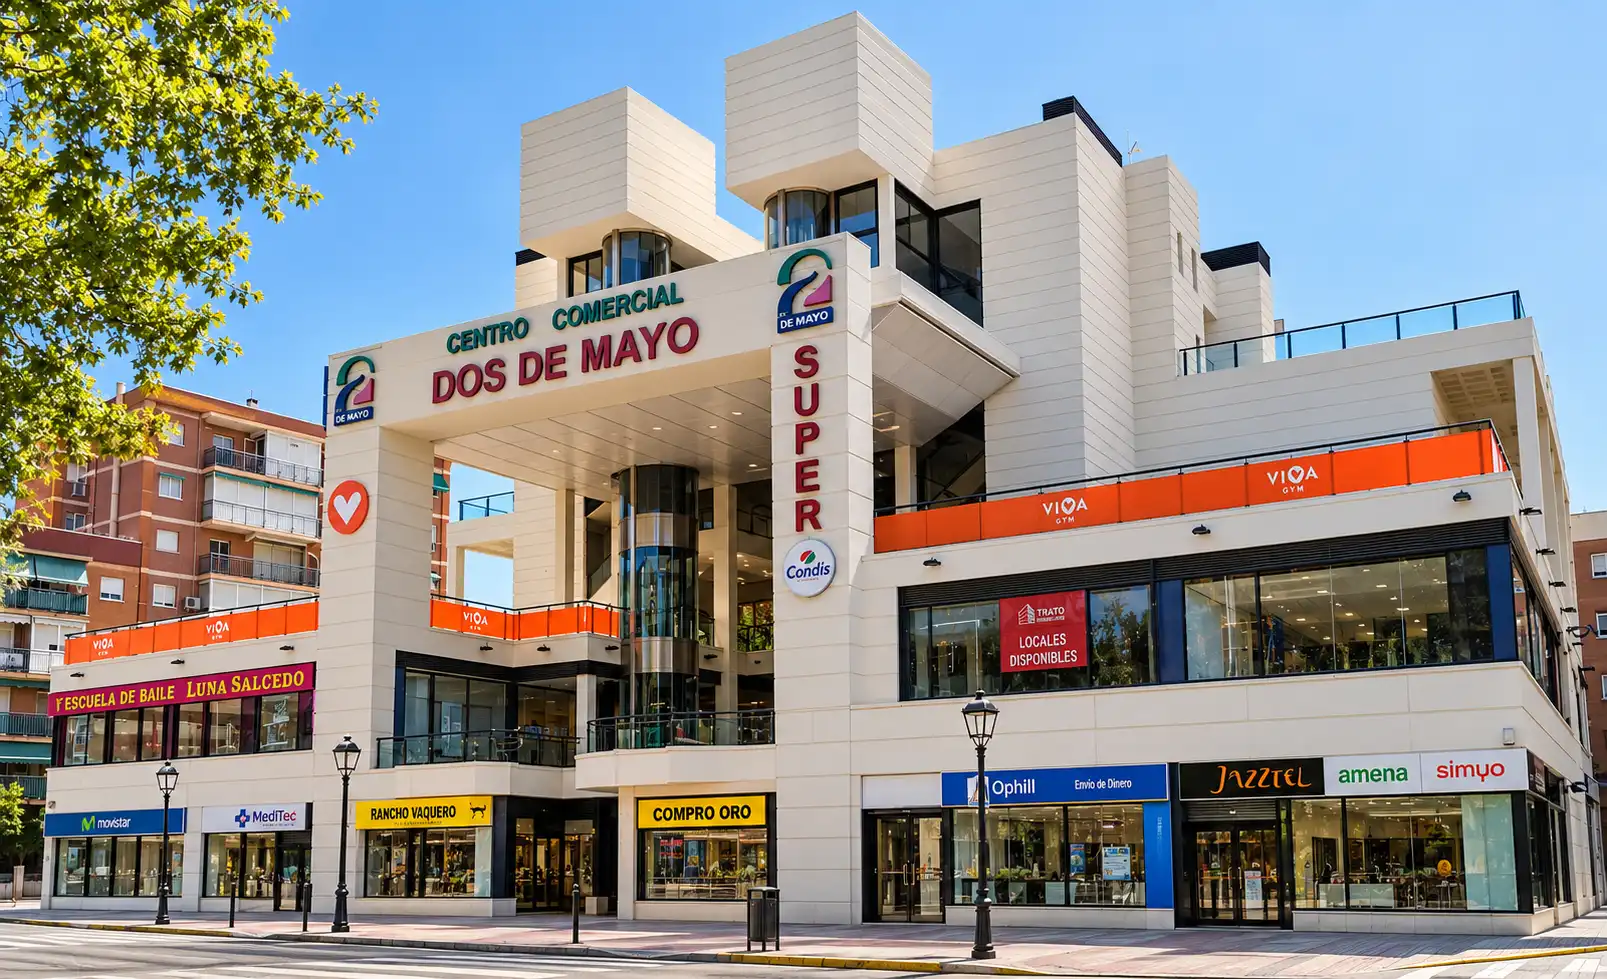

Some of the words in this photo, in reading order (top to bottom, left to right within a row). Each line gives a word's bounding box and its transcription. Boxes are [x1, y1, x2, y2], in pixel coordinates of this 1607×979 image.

[446, 316, 529, 354] CENTRO
[551, 281, 684, 331] COMERCIAL
[780, 318, 794, 329] DE
[795, 310, 829, 327] MAYO
[432, 358, 506, 404] DOS
[518, 344, 567, 386] DE
[580, 316, 700, 374] MAYO
[335, 412, 345, 423] DE
[347, 409, 369, 421] MAYO
[793, 345, 822, 533] SUPER
[1282, 485, 1304, 494] GYM
[1055, 516, 1075, 525] GYM
[786, 560, 830, 580] Condis
[1037, 606, 1065, 616] TRATO
[1018, 633, 1067, 649] LOCALES
[1008, 649, 1078, 668] DISPONIBLES
[64, 692, 116, 711] ESCUELA
[119, 689, 136, 705] DE
[139, 685, 176, 702] BAILE
[1338, 767, 1408, 784] amena
[1436, 760, 1505, 782] simyo
[992, 778, 1035, 798] Ophill
[1096, 779, 1106, 789] de
[1107, 777, 1132, 789] Dinero
[252, 810, 297, 822] MediTec
[370, 807, 409, 821] RANCHO
[411, 804, 457, 822] VAQUERO
[653, 805, 715, 821] COMPRO
[719, 804, 751, 820] ORO
[97, 816, 131, 829] movistar
